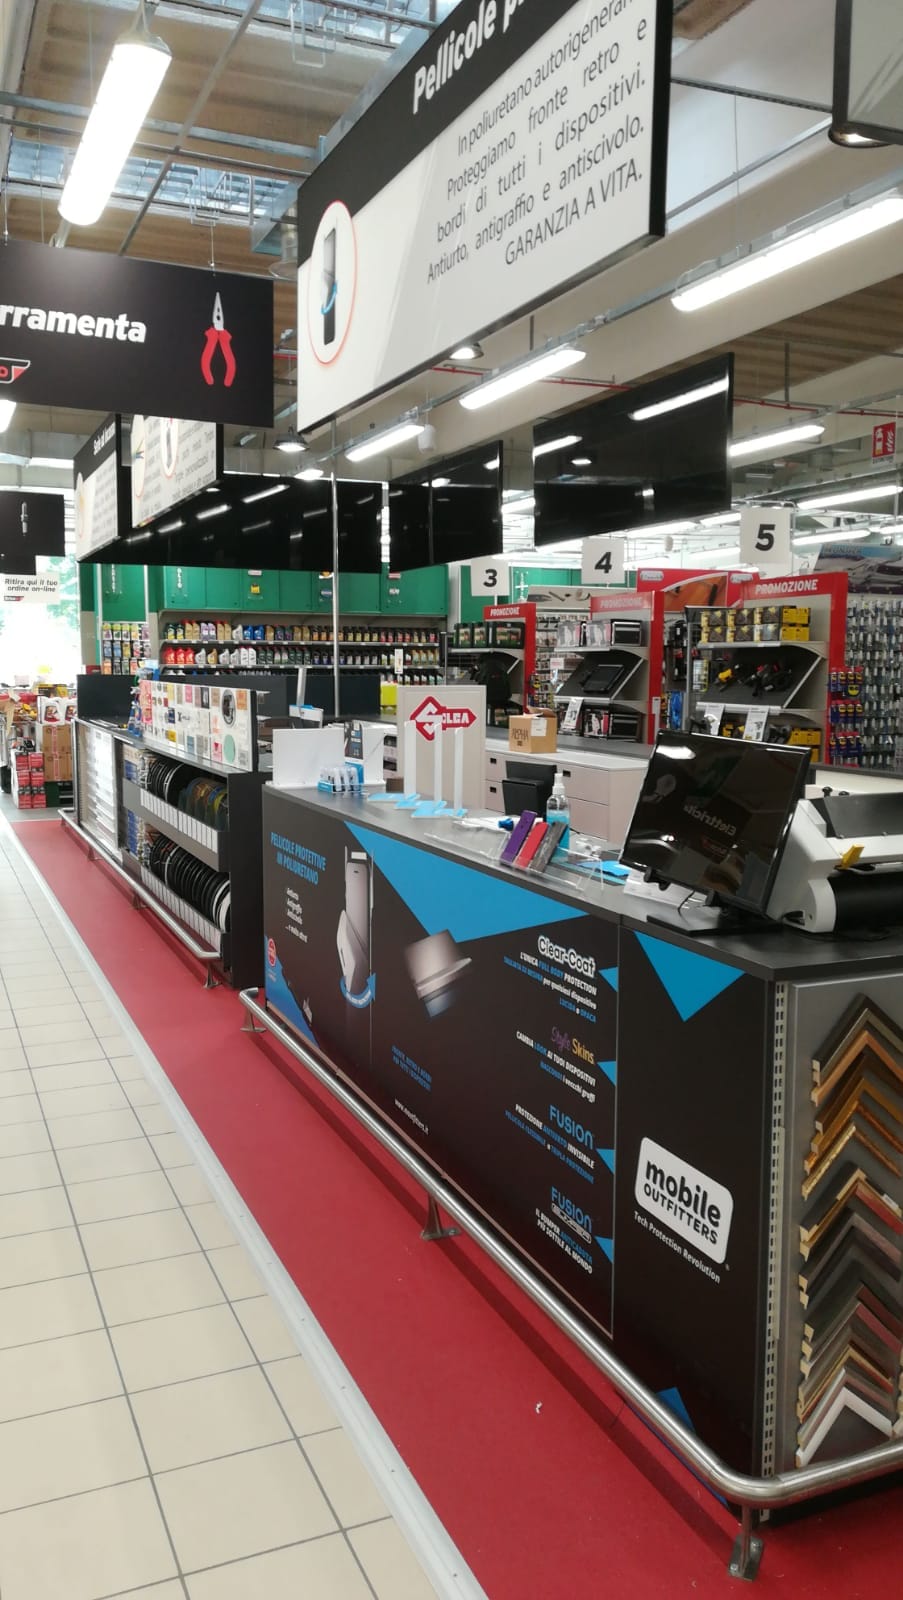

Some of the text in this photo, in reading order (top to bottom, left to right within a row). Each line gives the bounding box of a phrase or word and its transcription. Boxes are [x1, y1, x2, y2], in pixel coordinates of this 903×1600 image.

[412, 0, 526, 115] Pellicole p
[447, 18, 648, 200] Proteggiamo fronte retro e
[457, 133, 467, 157] In
[468, 76, 532, 153] poliuretano
[437, 62, 645, 243] bordi di tutti i dispositivi.
[427, 114, 644, 285] Antiurto, antigraffio e antiscivolo.
[505, 158, 643, 265] GARANZIA A VITA.
[754, 523, 776, 552] 5
[482, 567, 498, 589] 3
[594, 550, 612, 575] 4
[755, 578, 820, 596] PROMOZIONE
[489, 605, 521, 618] PROMOZIONE
[270, 832, 327, 872] PELLICOLE PROTETTIVE
[283, 855, 319, 886] POLIURETANO
[537, 935, 597, 979] Clear-Coat
[564, 972, 598, 997] PROTECTION
[571, 1038, 595, 1065] Skins
[565, 1061, 596, 1087] DISPOSITIVI
[515, 1103, 543, 1130] PROTEZIONE
[644, 1183, 718, 1245] OUTFITTERS
[645, 1160, 721, 1227] mobile
[545, 1227, 565, 1250] SOTTILE
[564, 1243, 572, 1256] AL
[572, 1251, 593, 1274] MONDO
[634, 1210, 721, 1284] Tech Protection Revolution
